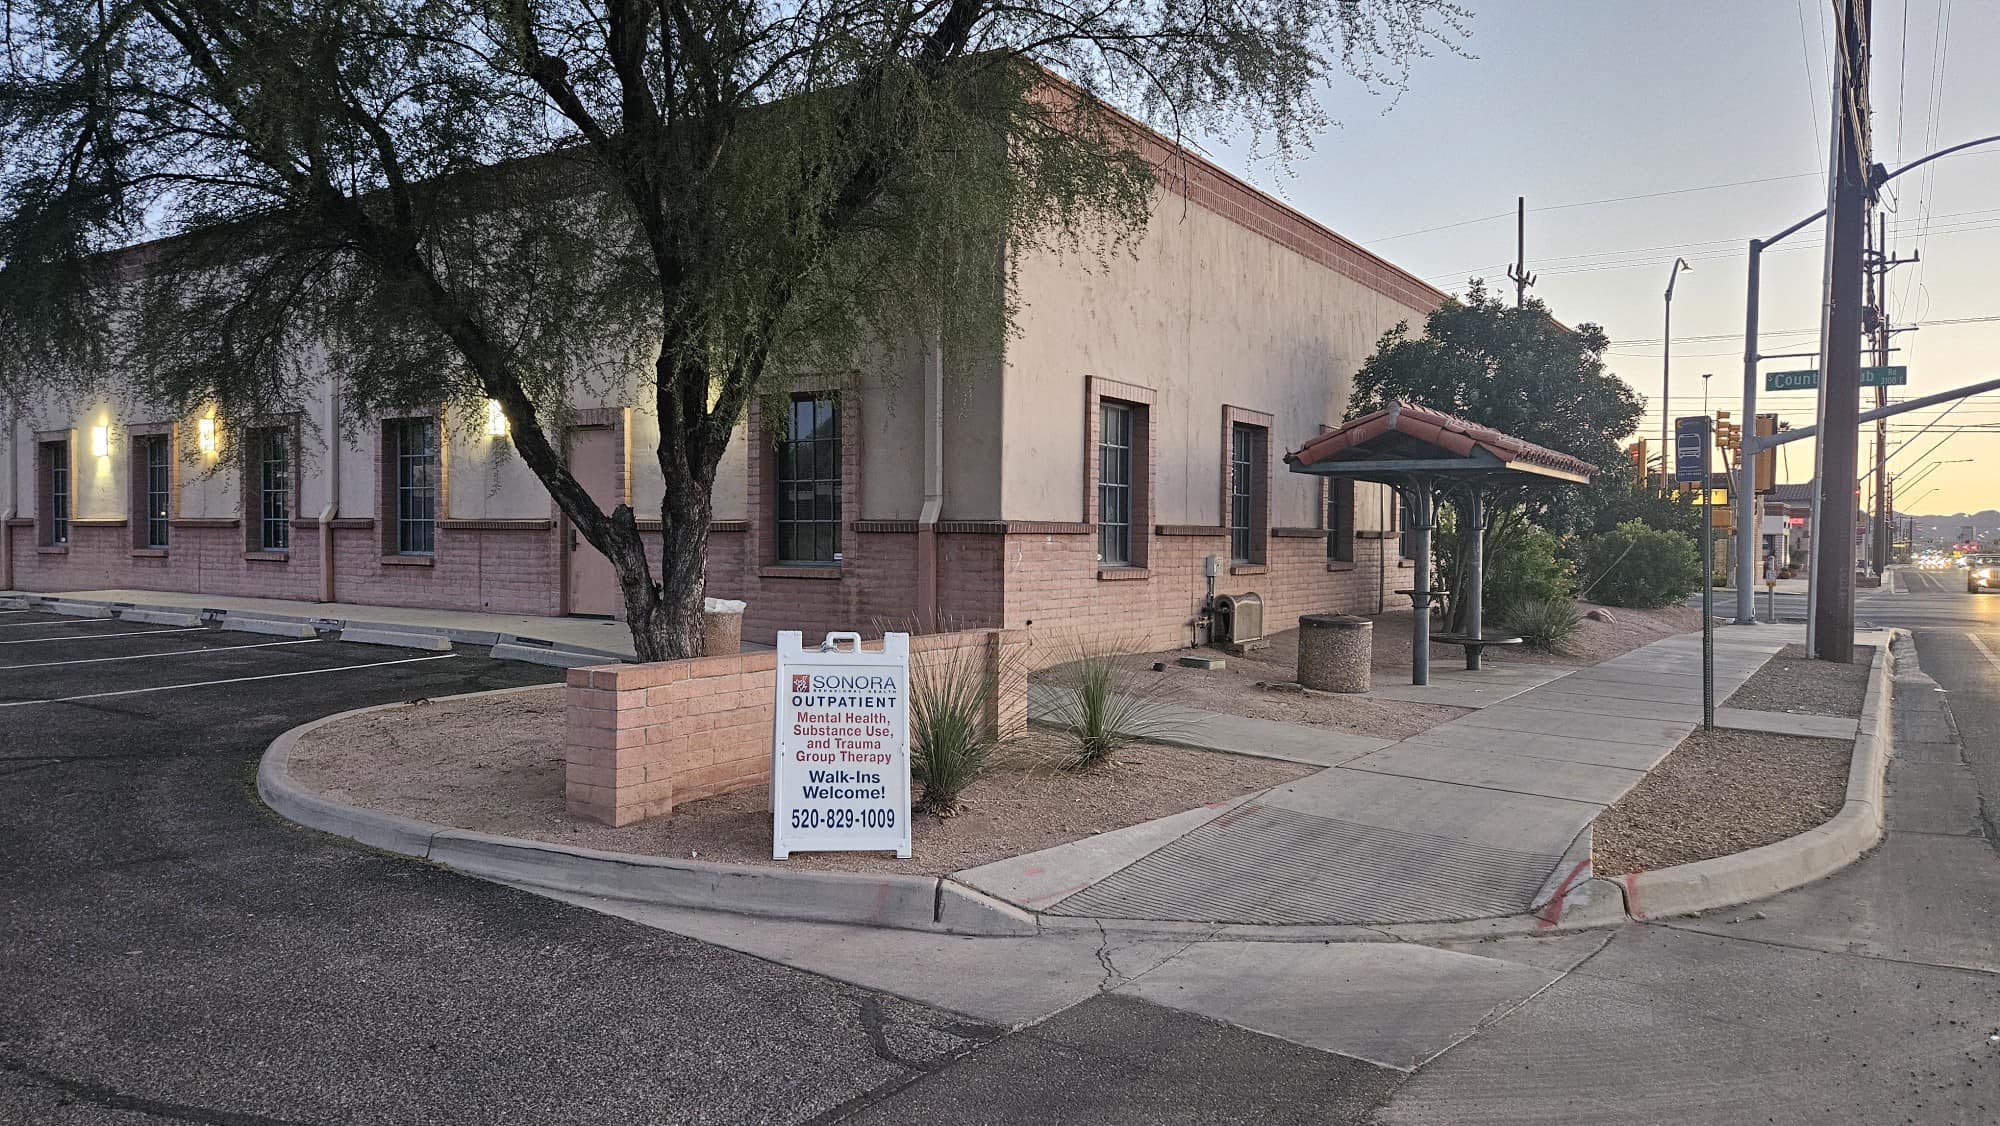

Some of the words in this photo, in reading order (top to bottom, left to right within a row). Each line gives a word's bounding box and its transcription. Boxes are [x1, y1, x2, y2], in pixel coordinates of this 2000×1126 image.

[1775, 372, 1819, 388] Count
[813, 676, 896, 690] SONORA
[792, 696, 896, 708] OUTPATIENT
[797, 712, 841, 724] Mental
[846, 713, 890, 726] Health,
[794, 725, 862, 736] Substance
[866, 726, 894, 738] Use,
[807, 738, 831, 749] and
[835, 739, 881, 750] Trauma
[796, 750, 836, 764] Group
[840, 751, 892, 765] Therapy
[809, 770, 880, 784] Walk-Ins
[802, 786, 885, 800] Welcome!
[792, 808, 895, 829] 520-829-1009
